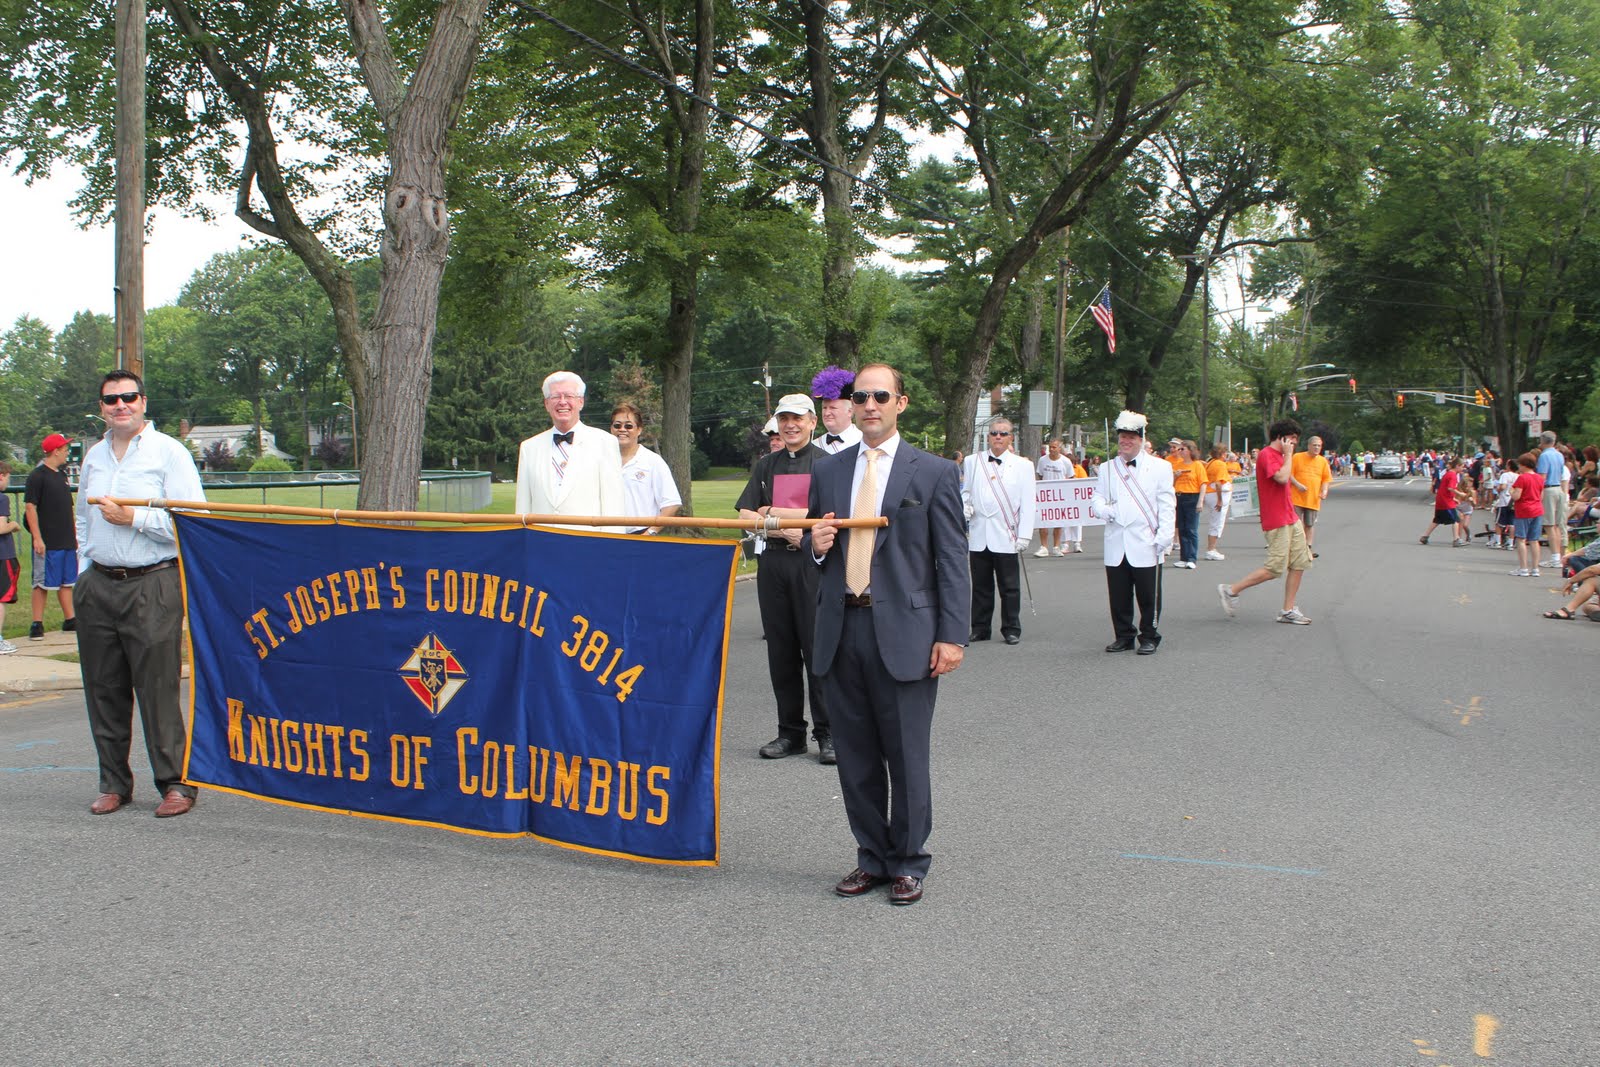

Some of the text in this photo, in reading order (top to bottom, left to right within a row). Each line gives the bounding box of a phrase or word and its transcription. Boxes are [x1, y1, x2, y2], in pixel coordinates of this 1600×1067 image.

[1042, 507, 1079, 521] HOOKED
[244, 562, 644, 703] ST. JOSEPH'S COUNCIL 3814
[227, 697, 670, 826] KNIGHTS OF COLUMBUS
